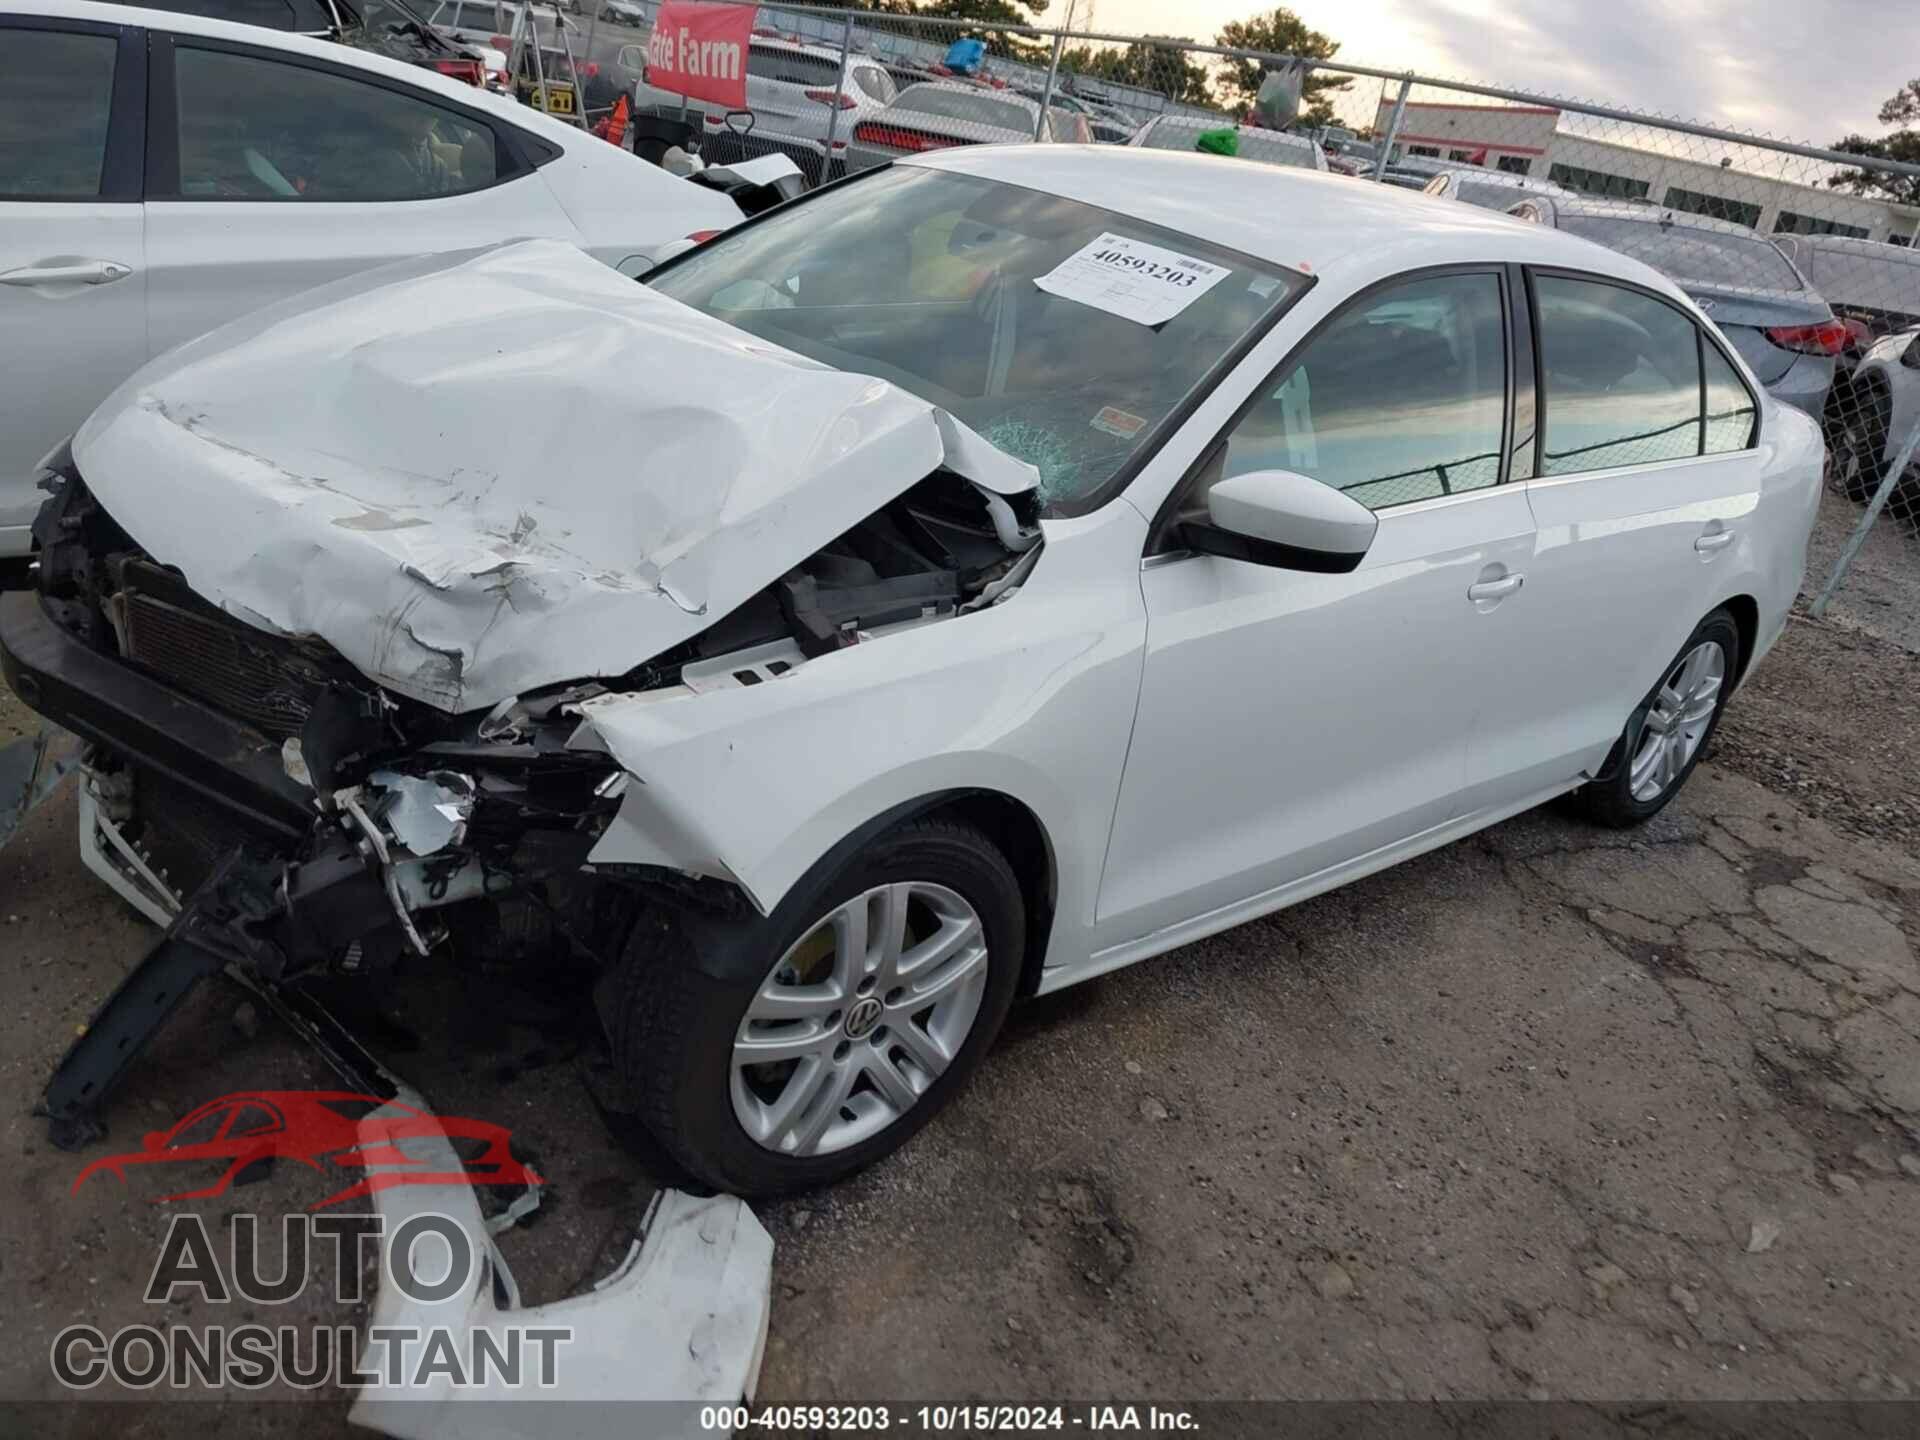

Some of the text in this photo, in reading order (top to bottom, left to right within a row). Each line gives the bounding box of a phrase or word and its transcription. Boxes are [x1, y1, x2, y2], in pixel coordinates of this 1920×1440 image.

[648, 27, 740, 80] tate Farm
[1093, 250, 1197, 286] 40593203
